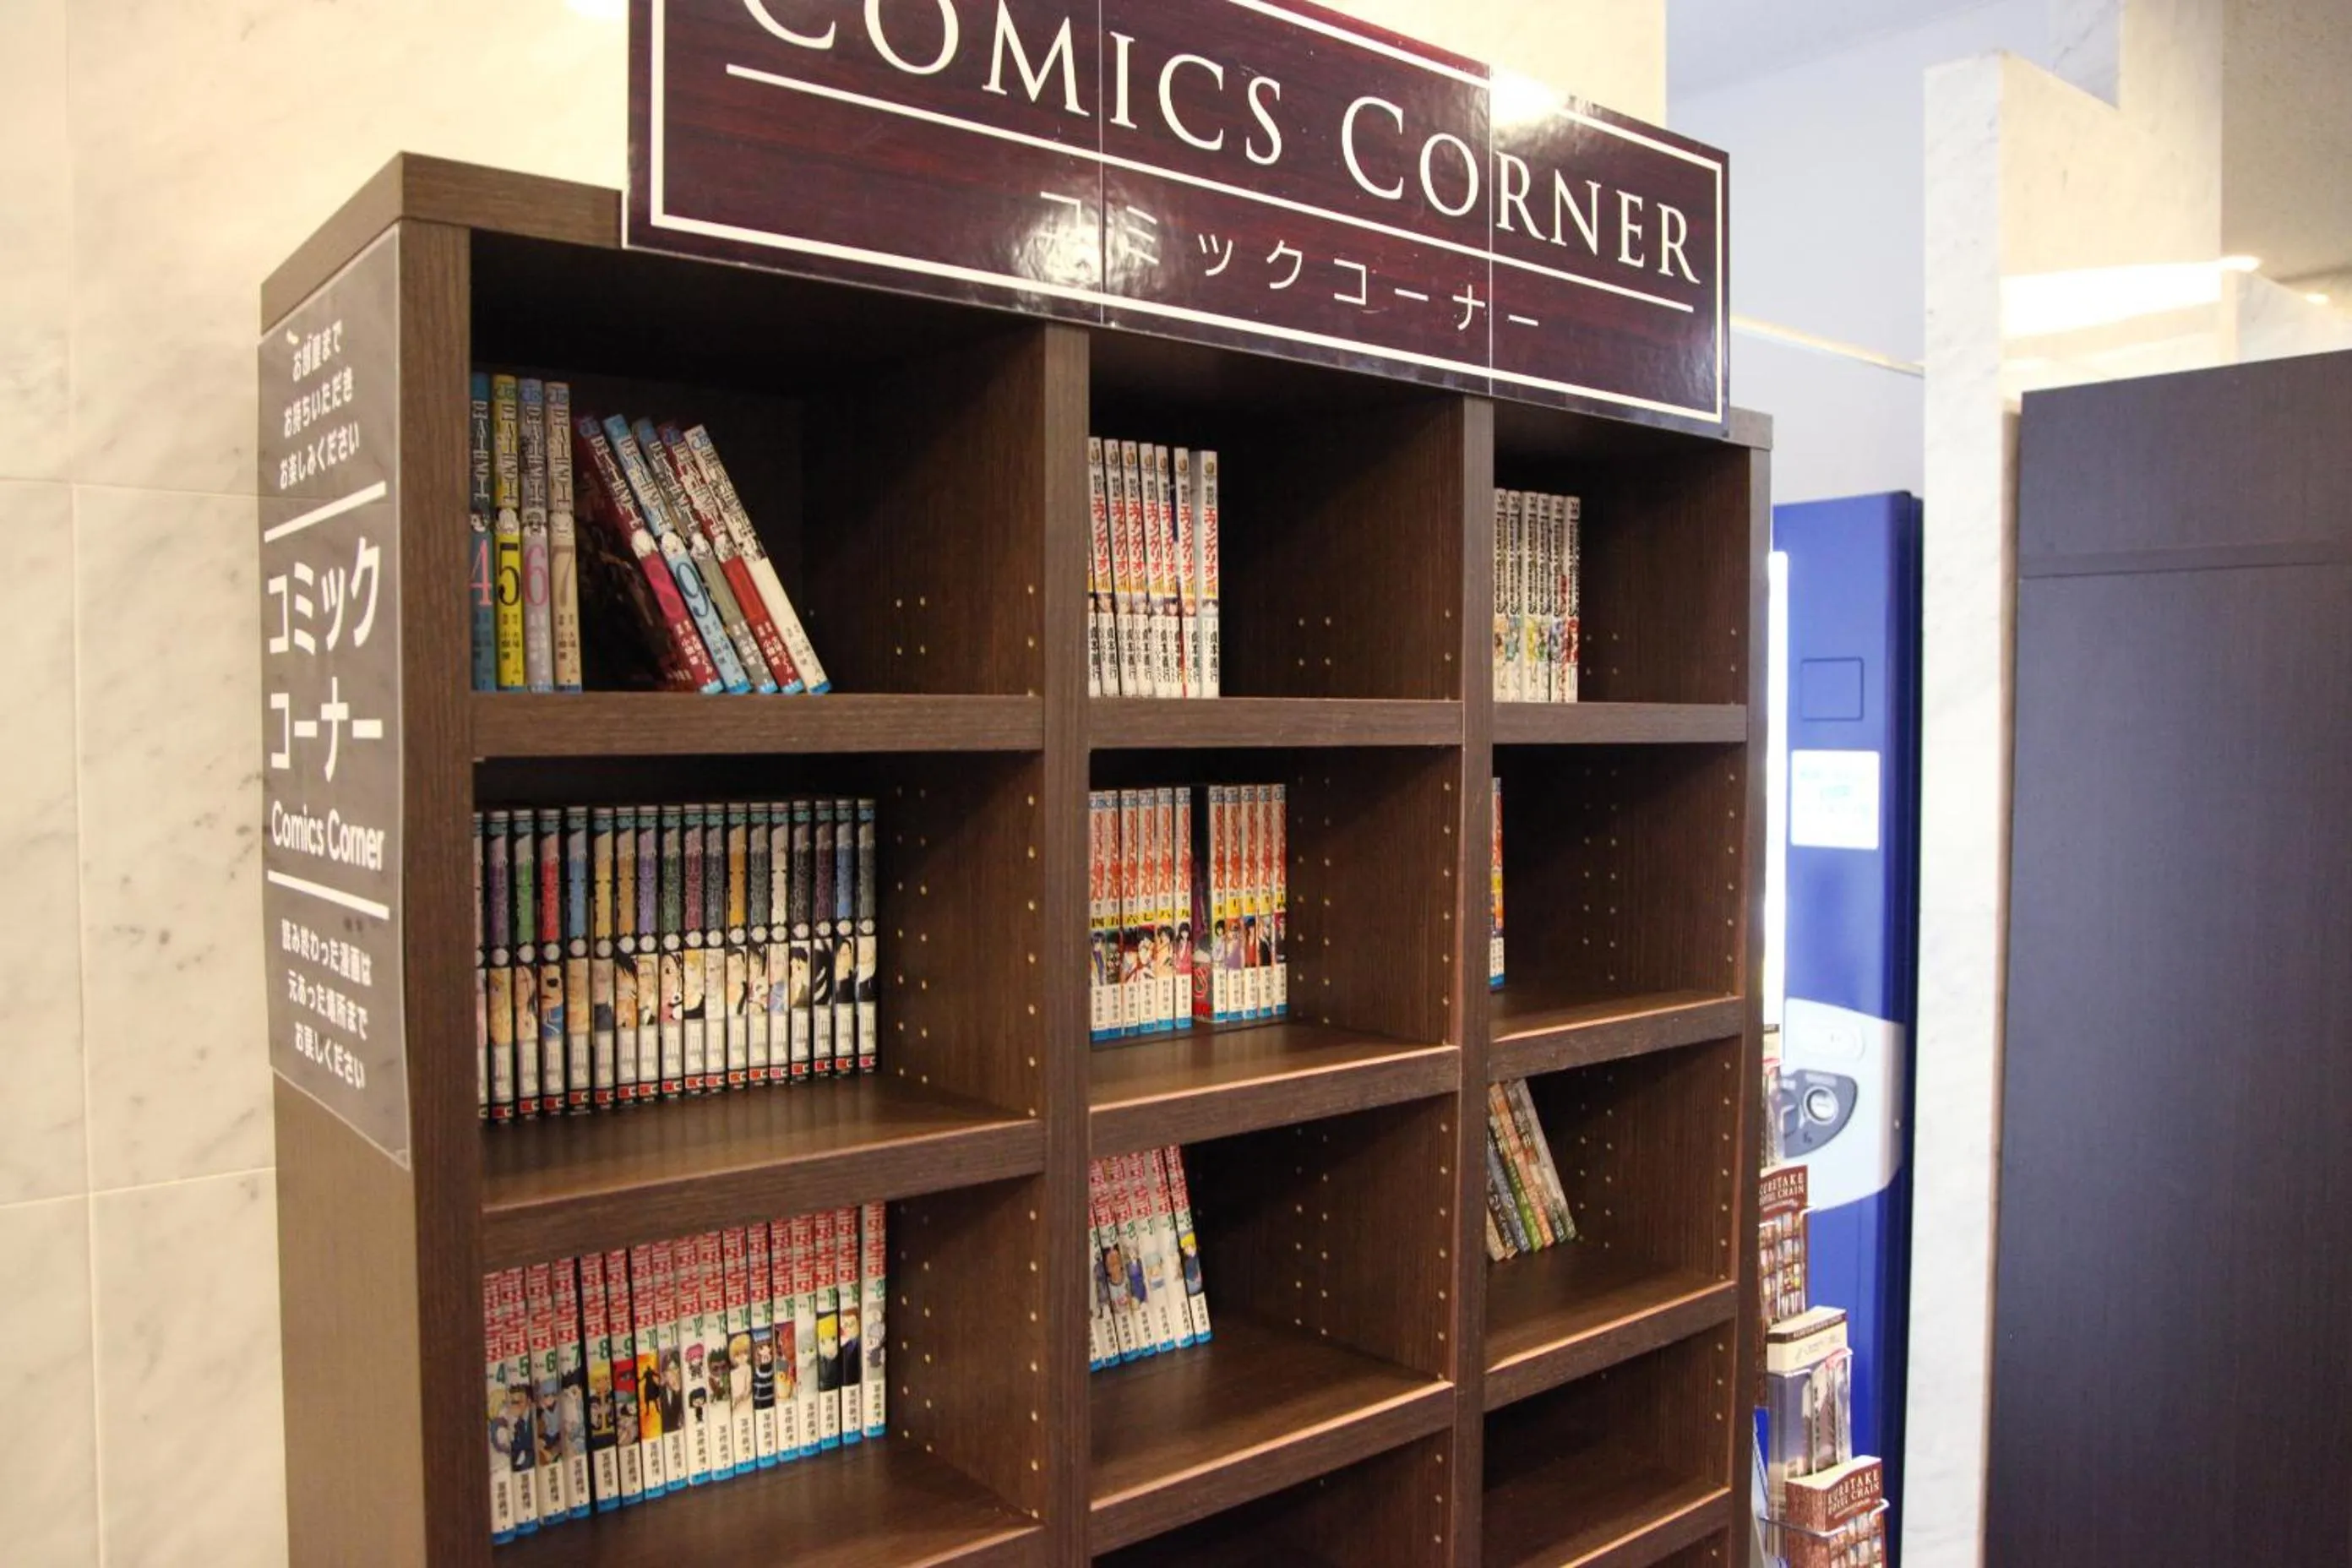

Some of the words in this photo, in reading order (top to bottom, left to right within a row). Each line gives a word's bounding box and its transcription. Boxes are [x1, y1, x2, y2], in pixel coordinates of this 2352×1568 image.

[1340, 95, 1701, 285] CORNER
[268, 536, 380, 656] コミック
[470, 539, 493, 607] 4
[498, 542, 520, 607] 5
[524, 542, 549, 607] 6
[675, 561, 710, 619] 9
[270, 676, 384, 782] コーナー
[271, 800, 325, 858] Comics
[327, 808, 385, 871] Corner
